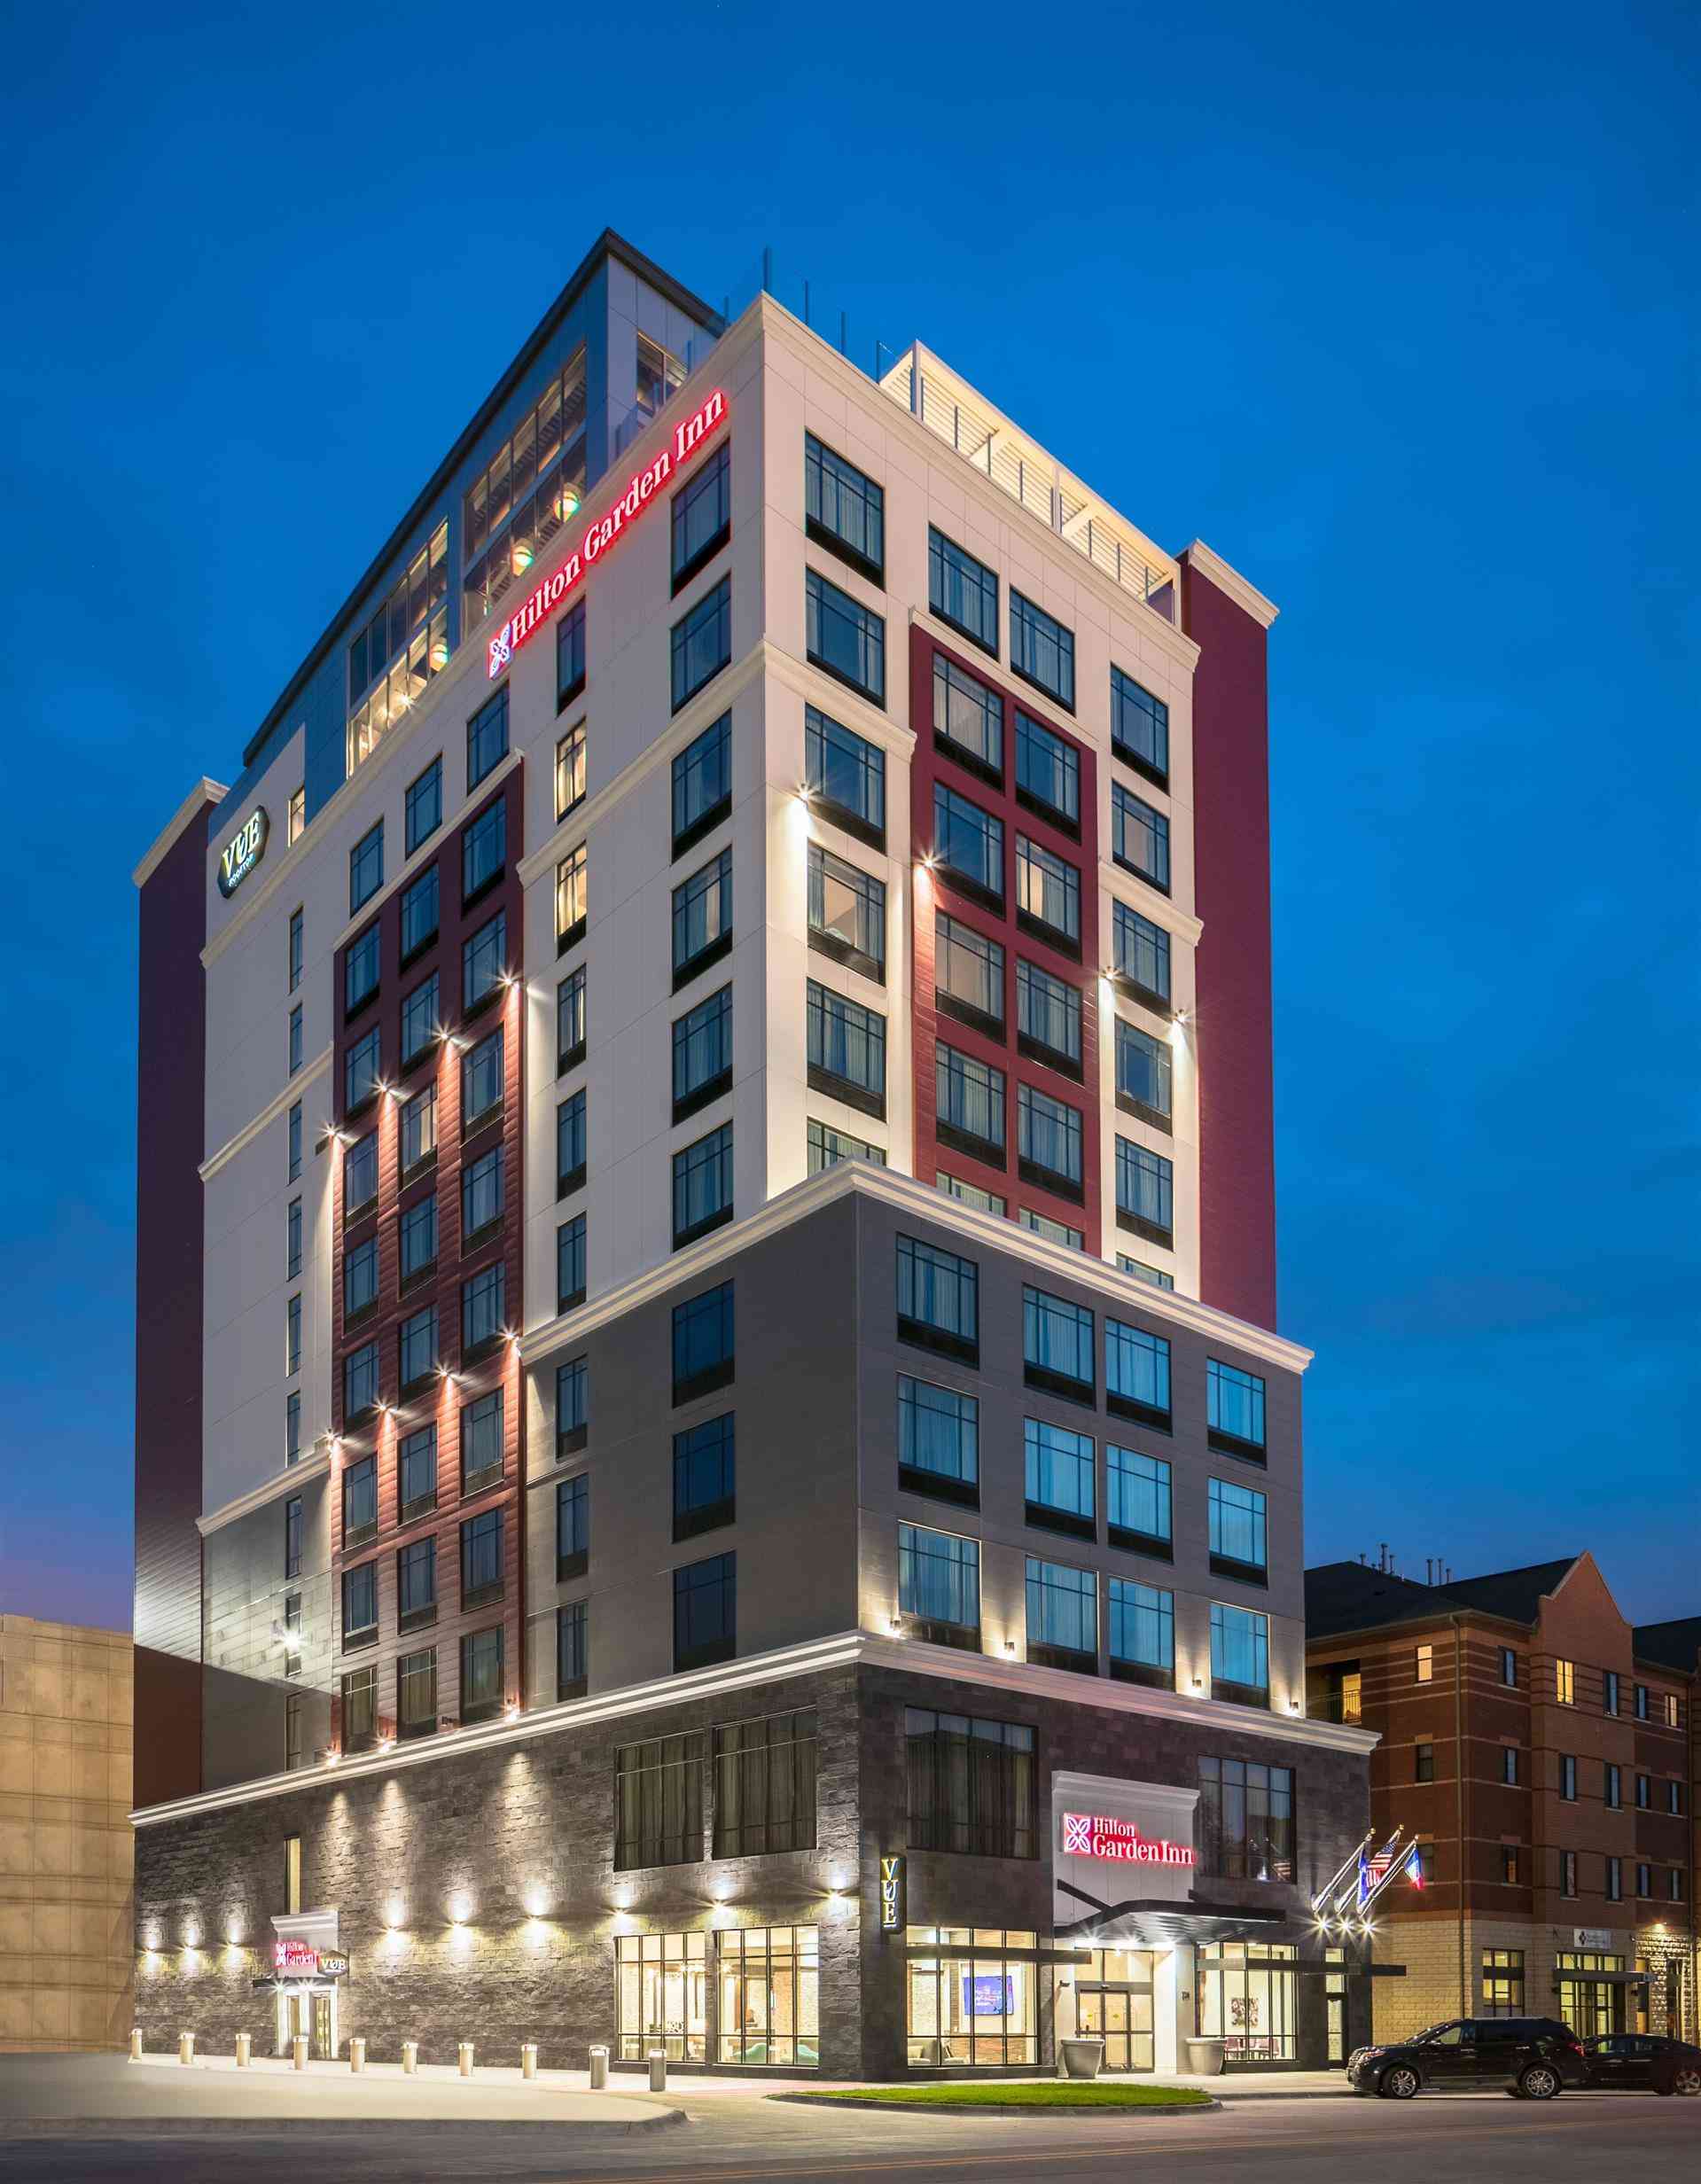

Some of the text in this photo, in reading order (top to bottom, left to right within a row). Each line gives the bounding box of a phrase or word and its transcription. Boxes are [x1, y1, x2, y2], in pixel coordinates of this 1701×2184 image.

[511, 390, 724, 649] Hilton Garden Inn
[222, 811, 261, 878] VUE
[1093, 1817, 1135, 1837] Hilton
[1093, 1834, 1194, 1865] Garden Inn
[880, 1857, 900, 1924] VUE
